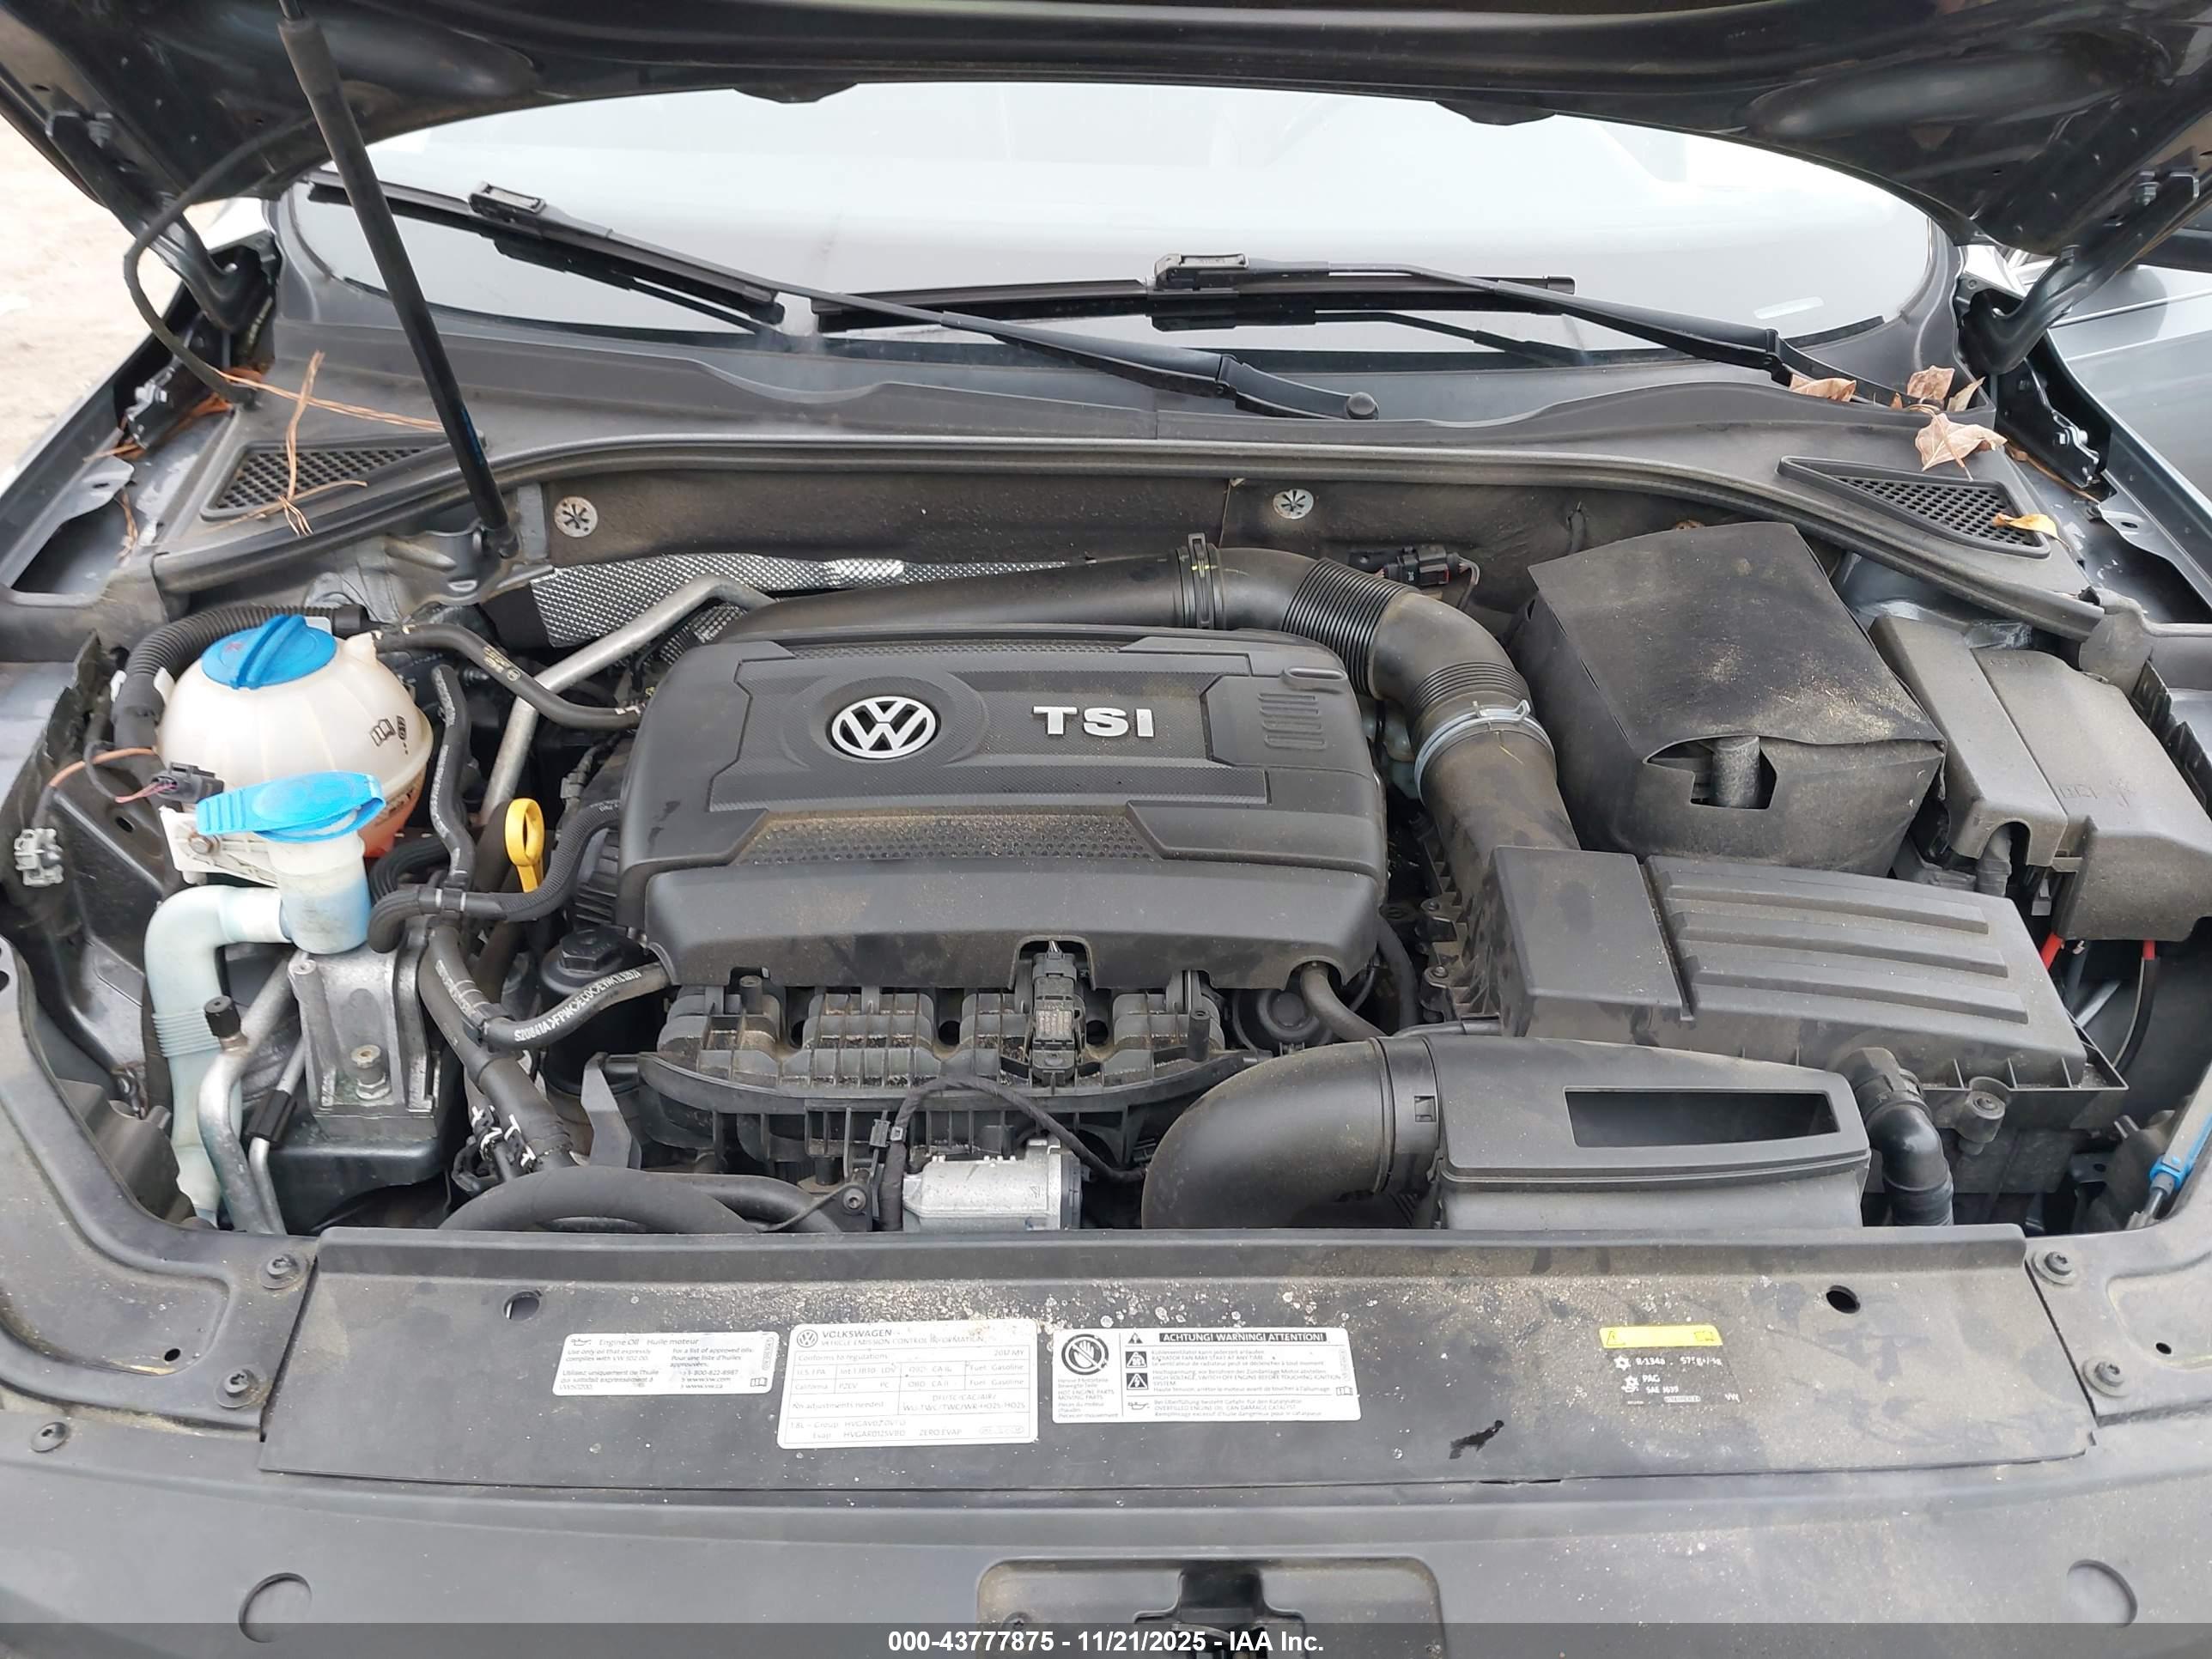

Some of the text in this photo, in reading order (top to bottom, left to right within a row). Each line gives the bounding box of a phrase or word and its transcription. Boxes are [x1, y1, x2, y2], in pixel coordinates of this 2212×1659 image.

[1033, 706, 1155, 738] TSI
[822, 1328, 892, 1340] VOLKSWAGEN
[1163, 1333, 1324, 1343] ACHTUNG! WARNING! ATTENTION!
[846, 1352, 888, 1363] regulations
[991, 1363, 1024, 1371] Gasoline
[991, 1378, 1024, 1387] Gasoline
[1642, 1374, 1661, 1383] PAG
